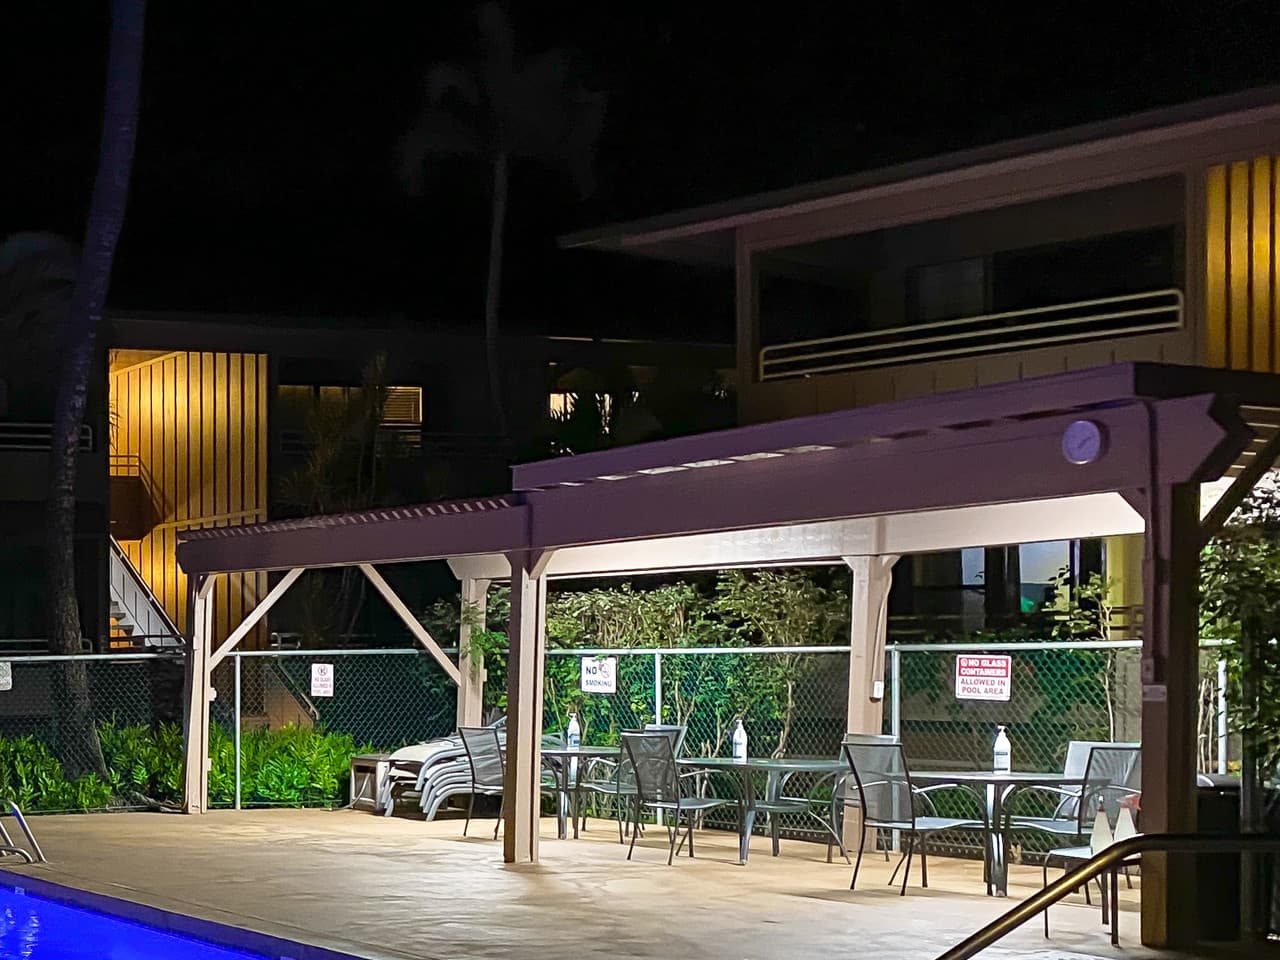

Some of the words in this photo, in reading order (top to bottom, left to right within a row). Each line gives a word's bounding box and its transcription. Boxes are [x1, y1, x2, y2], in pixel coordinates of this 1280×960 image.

[968, 659, 980, 667] NO
[980, 659, 1007, 667] GLASS
[586, 665, 598, 675] NO
[960, 668, 1007, 676] CONTAINERS
[586, 679, 612, 687] SMOKING
[960, 678, 996, 686] ALLOWED
[997, 679, 1006, 687] IN
[961, 686, 982, 694] POOL
[983, 687, 1004, 695] AREA
